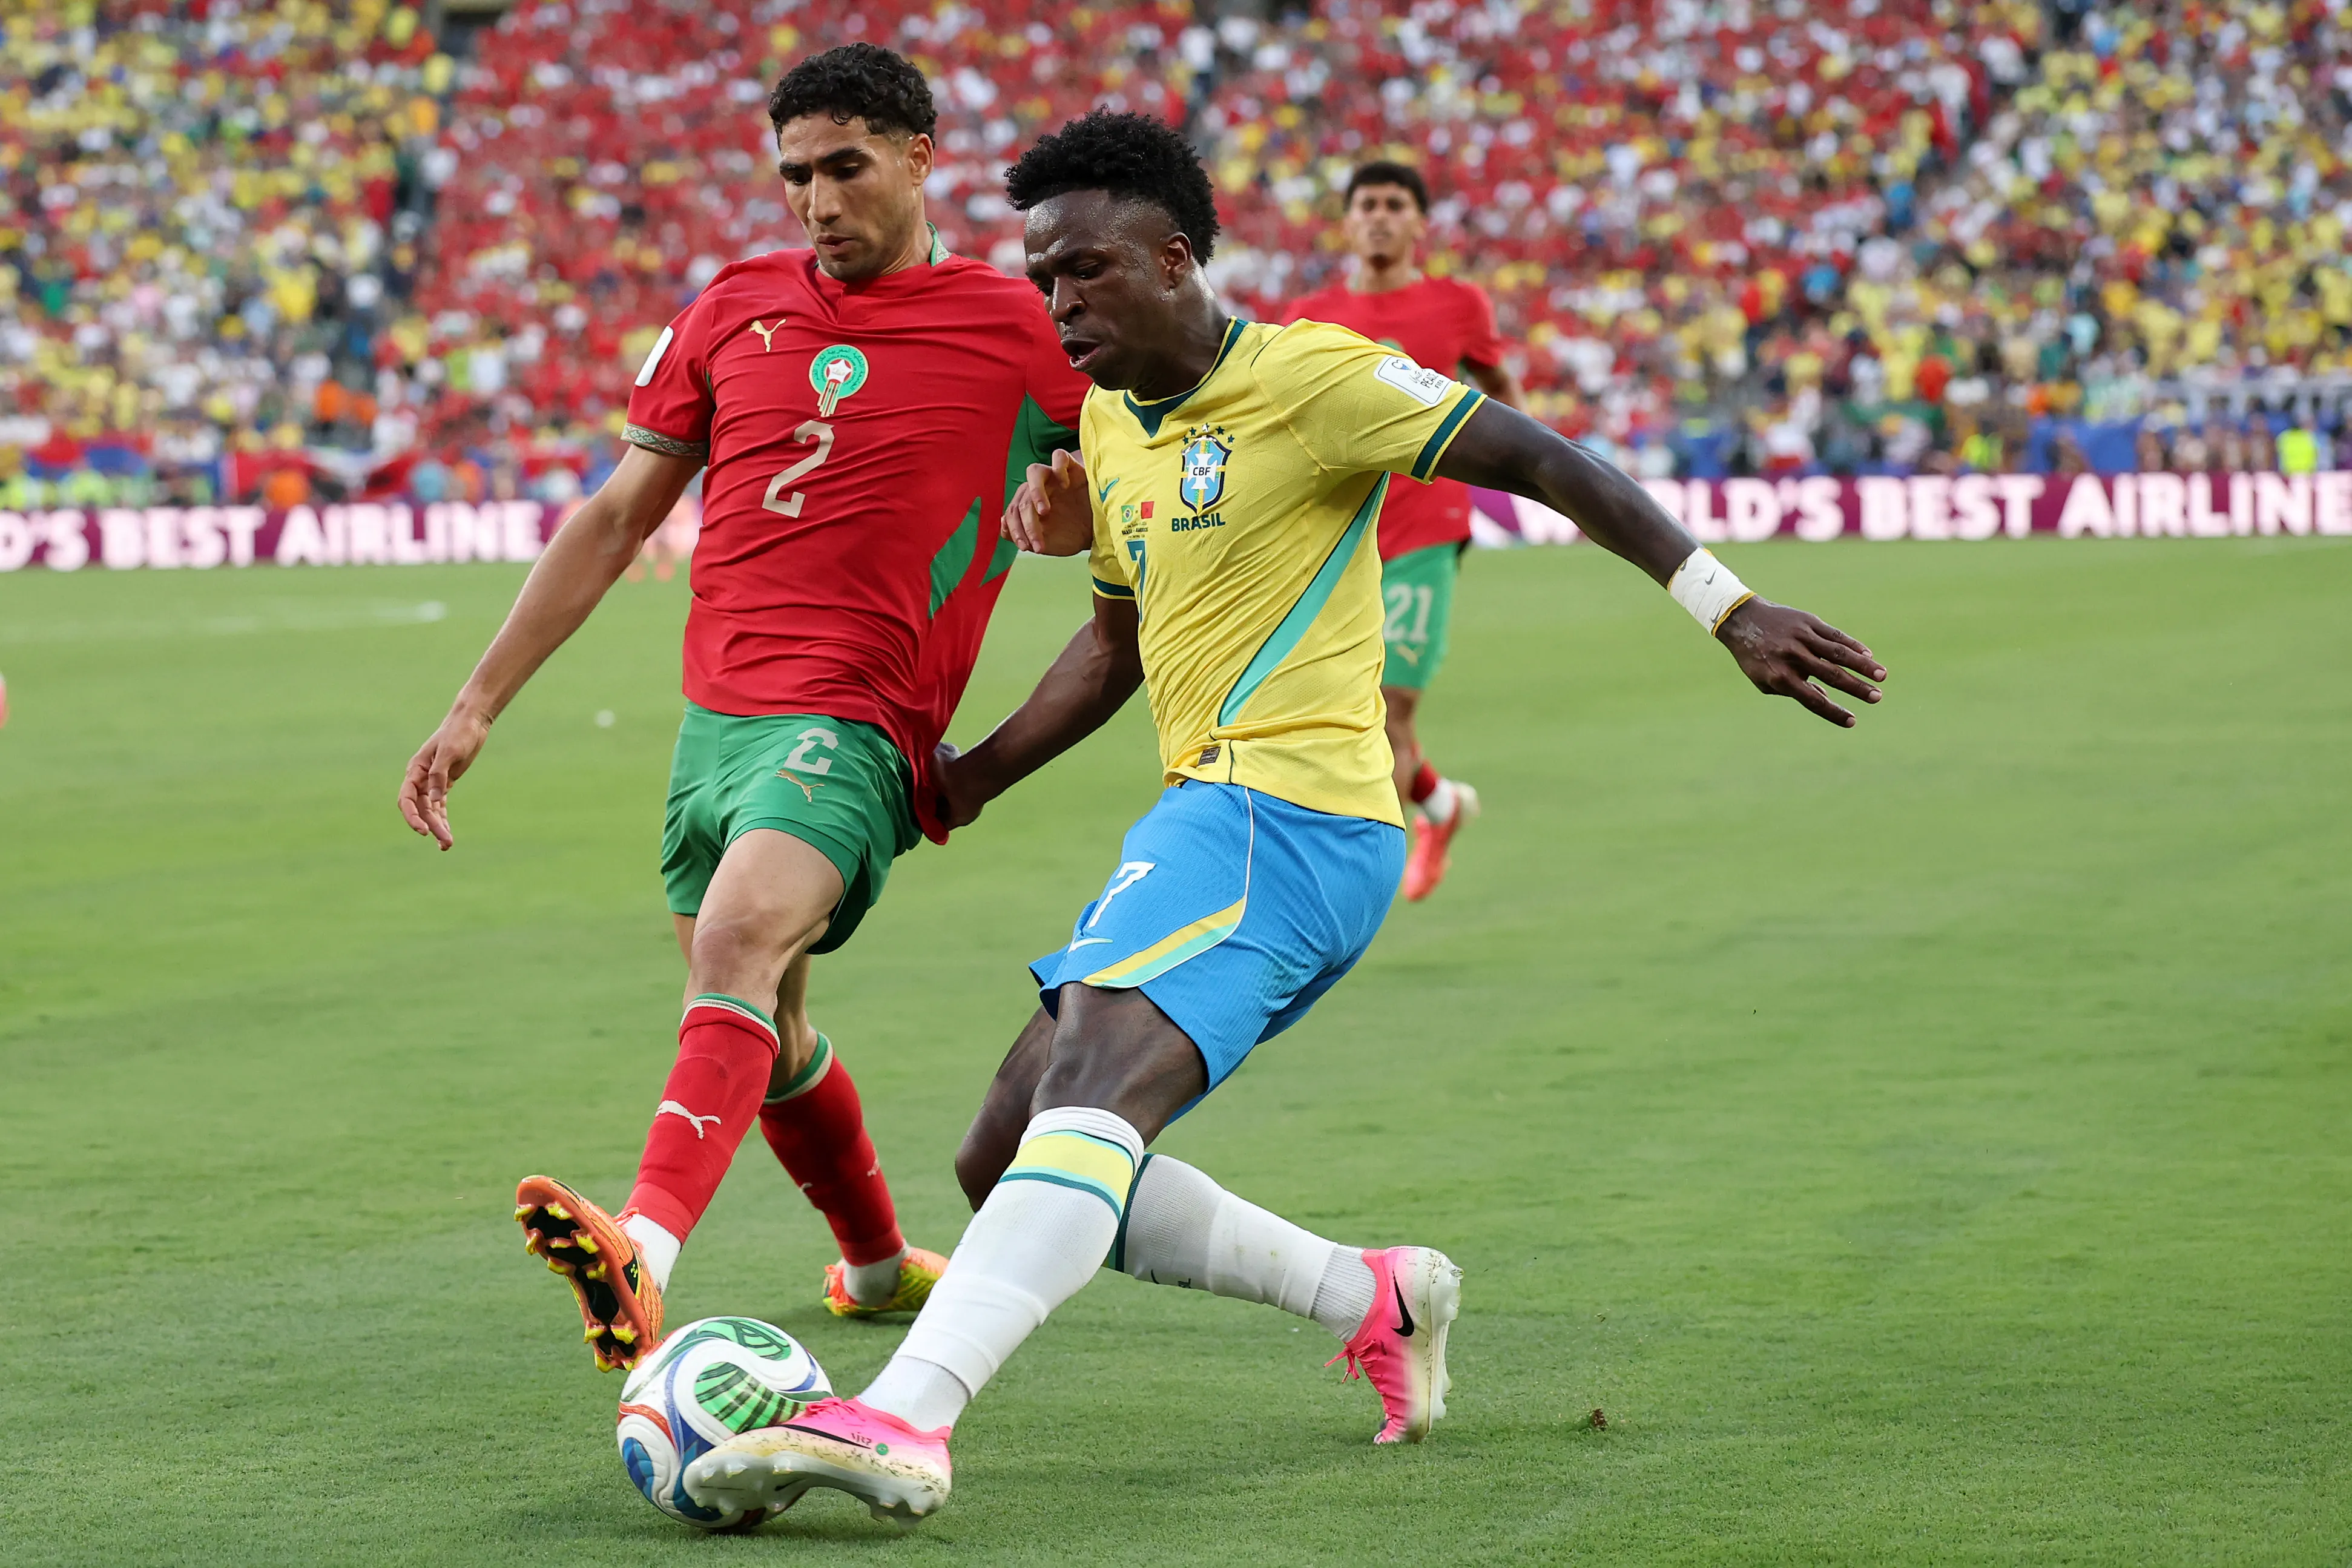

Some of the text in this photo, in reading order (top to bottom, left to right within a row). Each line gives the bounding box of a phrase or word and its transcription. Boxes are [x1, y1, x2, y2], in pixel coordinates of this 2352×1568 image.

[1434, 380, 1445, 389] FIFA
[762, 420, 835, 518] 2
[1193, 467, 1211, 476] CBF
[99, 506, 267, 570] BEST
[274, 501, 545, 567] AIRLINE
[1171, 512, 1226, 532] BRASIL
[1854, 475, 2046, 541] BEST
[2057, 472, 2352, 539] AIRLINE
[1126, 540, 1146, 624] 7
[1383, 582, 1434, 644] 21
[783, 727, 839, 776] 2
[1088, 861, 1157, 928] 7
